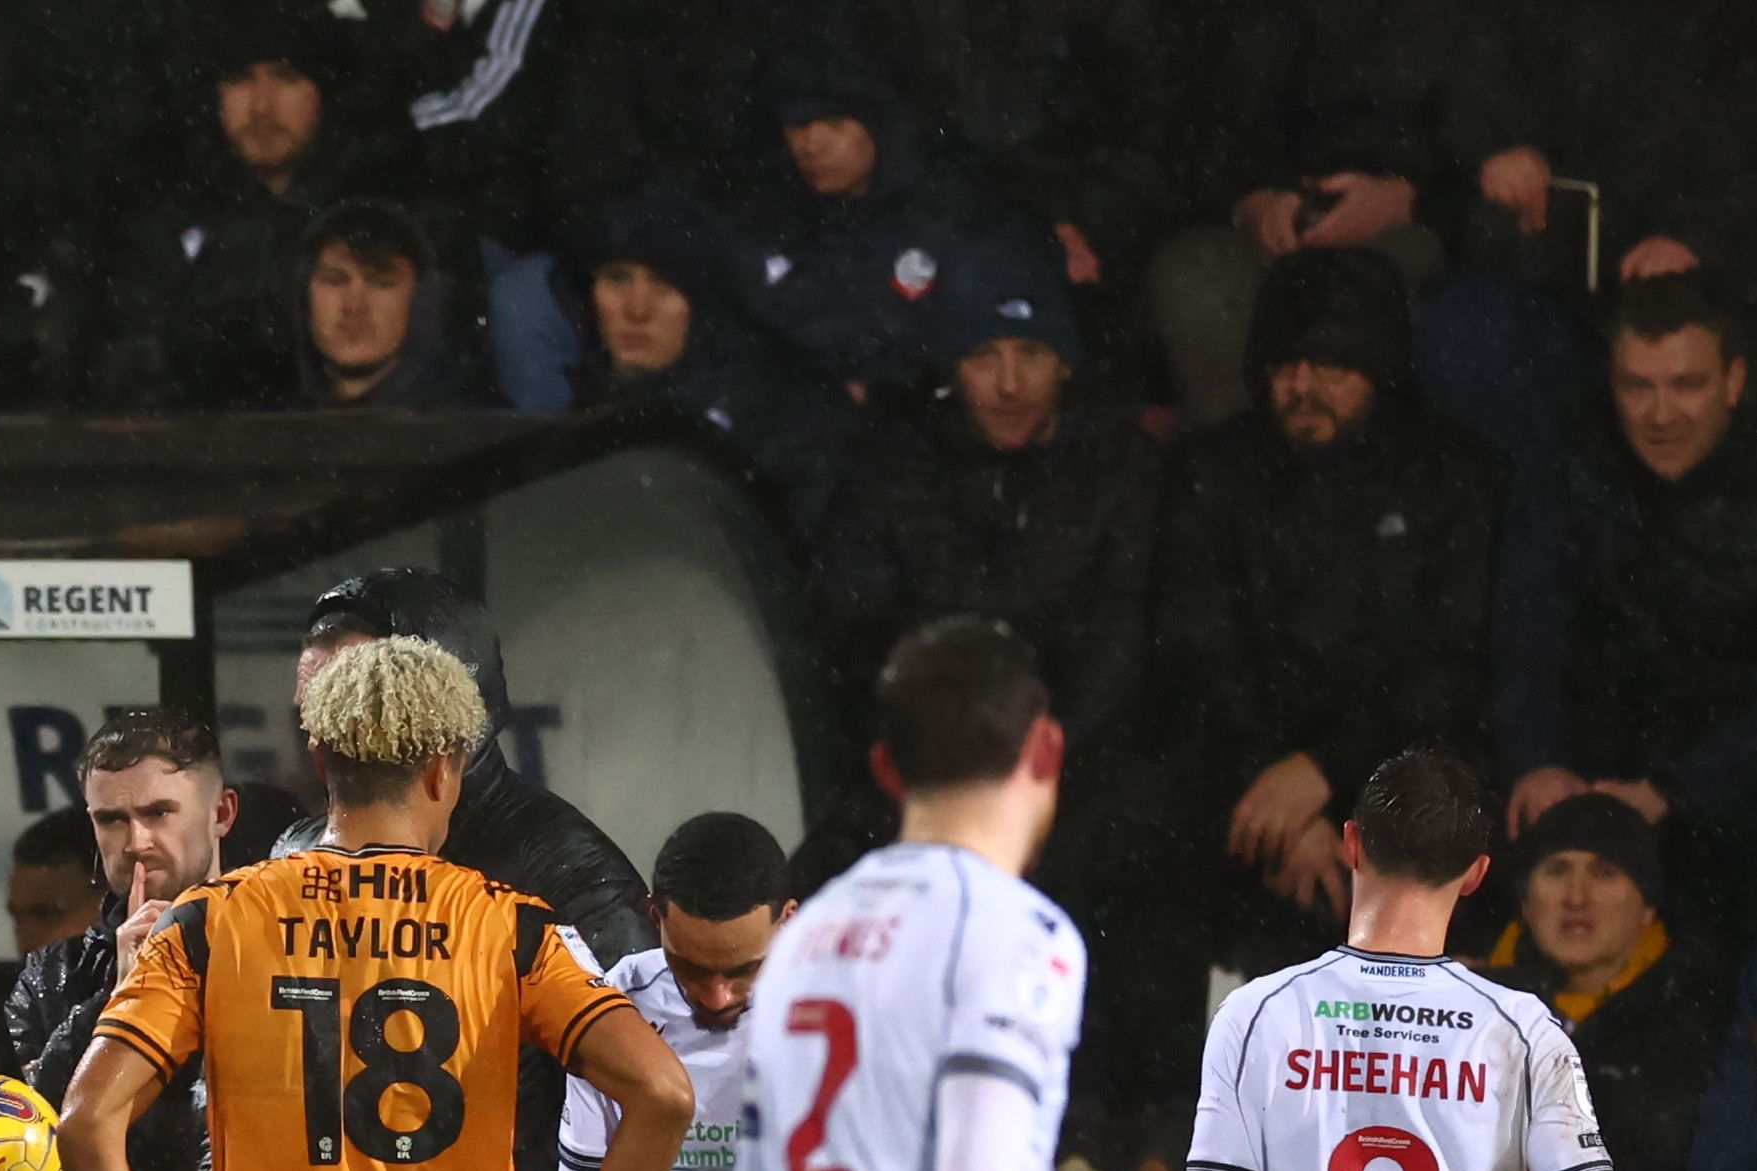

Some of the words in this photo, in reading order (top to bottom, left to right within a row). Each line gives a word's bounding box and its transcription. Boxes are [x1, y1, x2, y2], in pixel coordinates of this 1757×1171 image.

[25, 587, 150, 613] REGENT
[349, 863, 427, 903] Hill
[278, 916, 451, 961] TAYLOR
[1360, 965, 1426, 978] WANDERERS
[1314, 1000, 1473, 1030] ARBWORKS
[1337, 1024, 1370, 1039] Tree
[1374, 1026, 1440, 1044] Services
[271, 975, 466, 1166] 18
[1285, 1049, 1486, 1103] SHEEHAN
